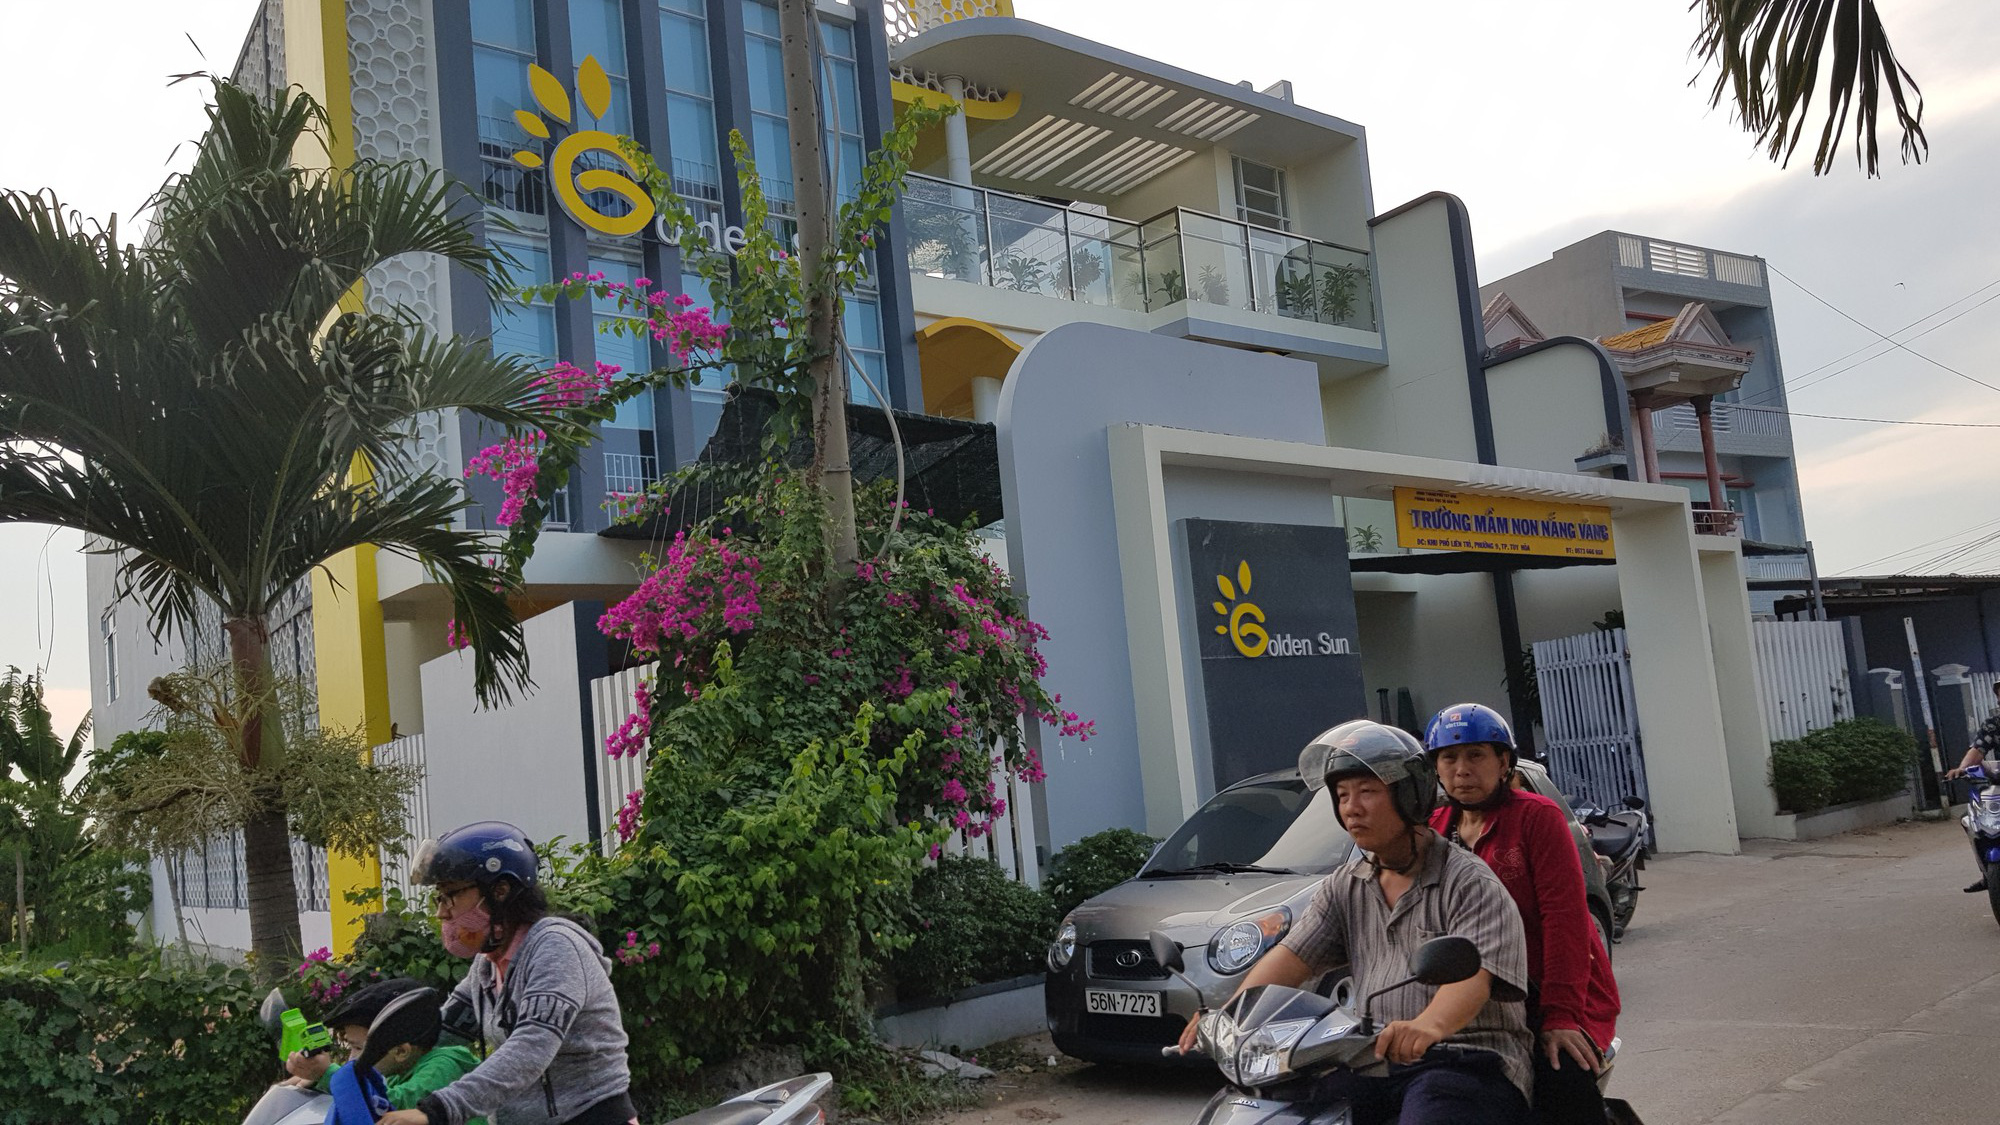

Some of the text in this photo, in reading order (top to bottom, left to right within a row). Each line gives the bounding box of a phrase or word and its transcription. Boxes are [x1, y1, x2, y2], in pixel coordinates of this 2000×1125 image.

[1511, 518, 1539, 536] NON
[1318, 633, 1350, 654] Sun
[1118, 952, 1139, 965] KIA
